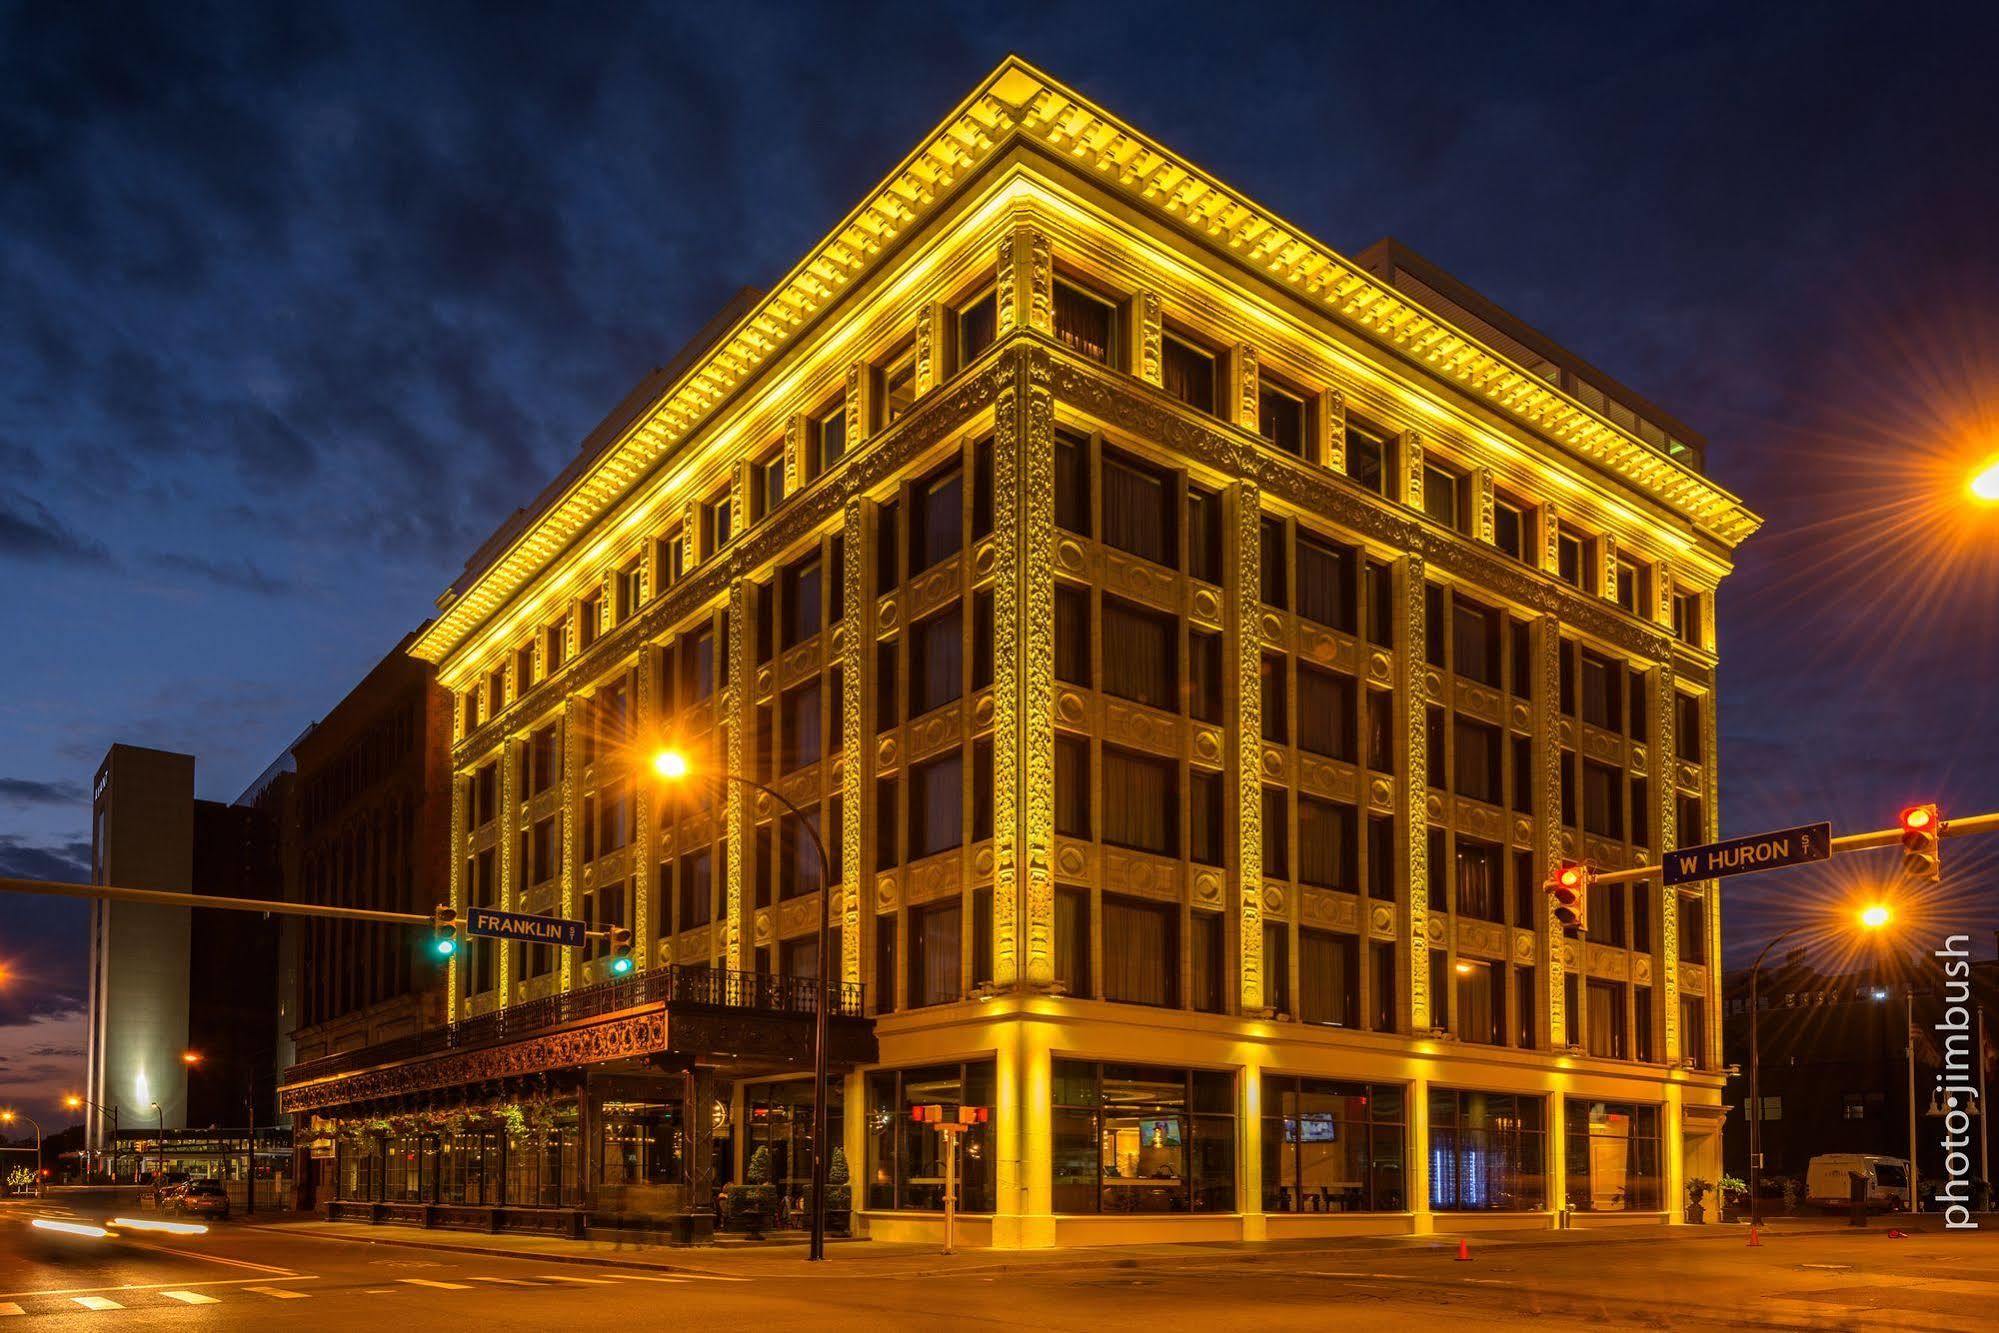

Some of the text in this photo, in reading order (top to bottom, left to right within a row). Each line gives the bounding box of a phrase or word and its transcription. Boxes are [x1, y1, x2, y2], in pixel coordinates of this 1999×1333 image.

[1680, 834, 1810, 875] W HURON ST
[477, 914, 576, 941] FRANKLIN ST
